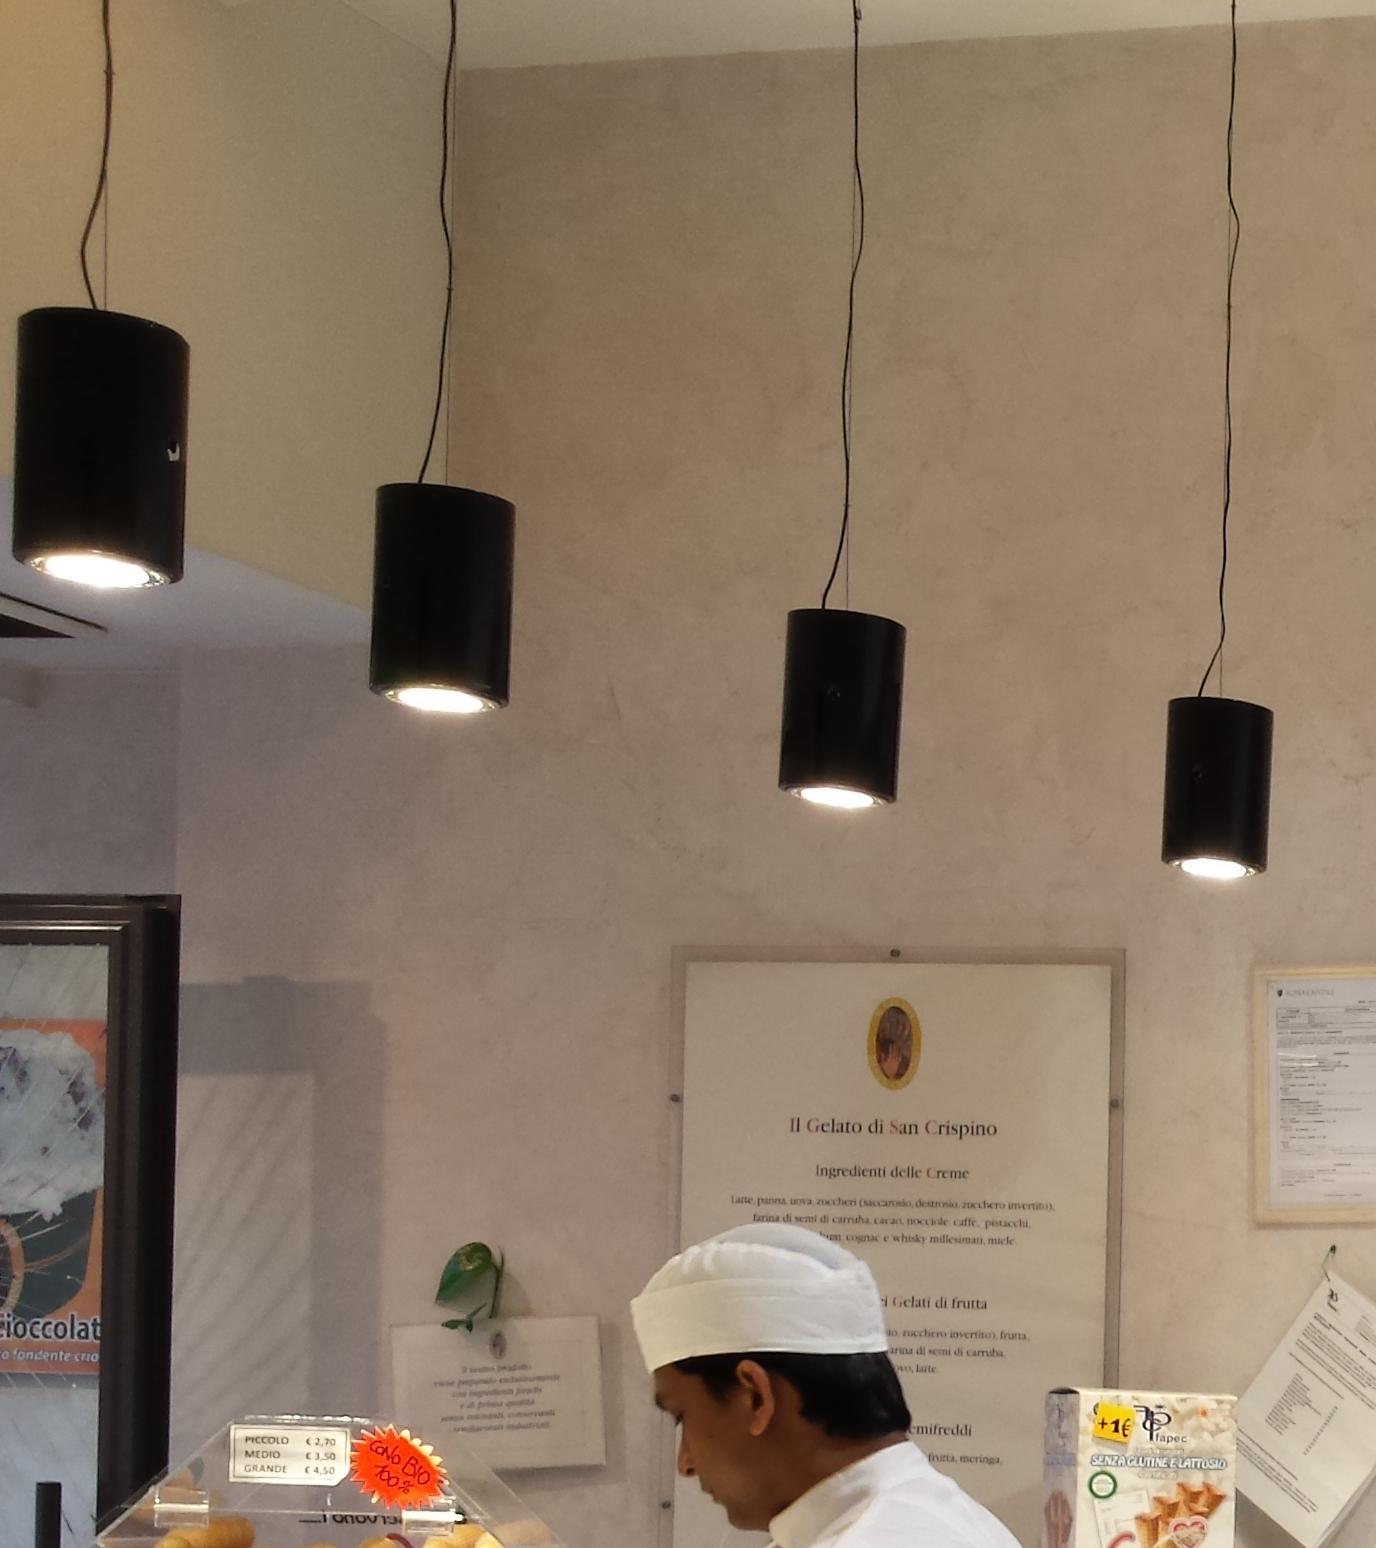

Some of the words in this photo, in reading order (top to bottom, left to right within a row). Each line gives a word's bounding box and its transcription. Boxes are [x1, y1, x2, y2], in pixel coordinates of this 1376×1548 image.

[789, 1117, 800, 1133] Il
[806, 1117, 863, 1134] Gelato
[868, 1118, 883, 1134] di
[889, 1119, 919, 1135] San
[924, 1119, 998, 1140] Crispino
[815, 1165, 887, 1179] Ingredienti
[890, 1166, 922, 1179] delle
[926, 1167, 970, 1180] Creme
[892, 1295, 931, 1308] Gelati
[935, 1296, 947, 1309] di
[951, 1296, 988, 1310] frutta
[0, 1312, 101, 1341] ioccolat
[13, 1348, 71, 1361] fondente
[908, 1423, 972, 1437] emifreddi
[244, 1436, 289, 1446] PICCOLO
[313, 1437, 336, 1447] 2,70
[1155, 1432, 1188, 1444] fapec
[244, 1450, 281, 1460] MEDIO
[313, 1452, 336, 1461] 3,50
[244, 1464, 288, 1474] GRANDE
[312, 1466, 335, 1475] 4,50
[1091, 1455, 1127, 1467] SENZA
[1128, 1456, 1170, 1469] GLUTINE
[1178, 1457, 1228, 1471] LATTOSIO
